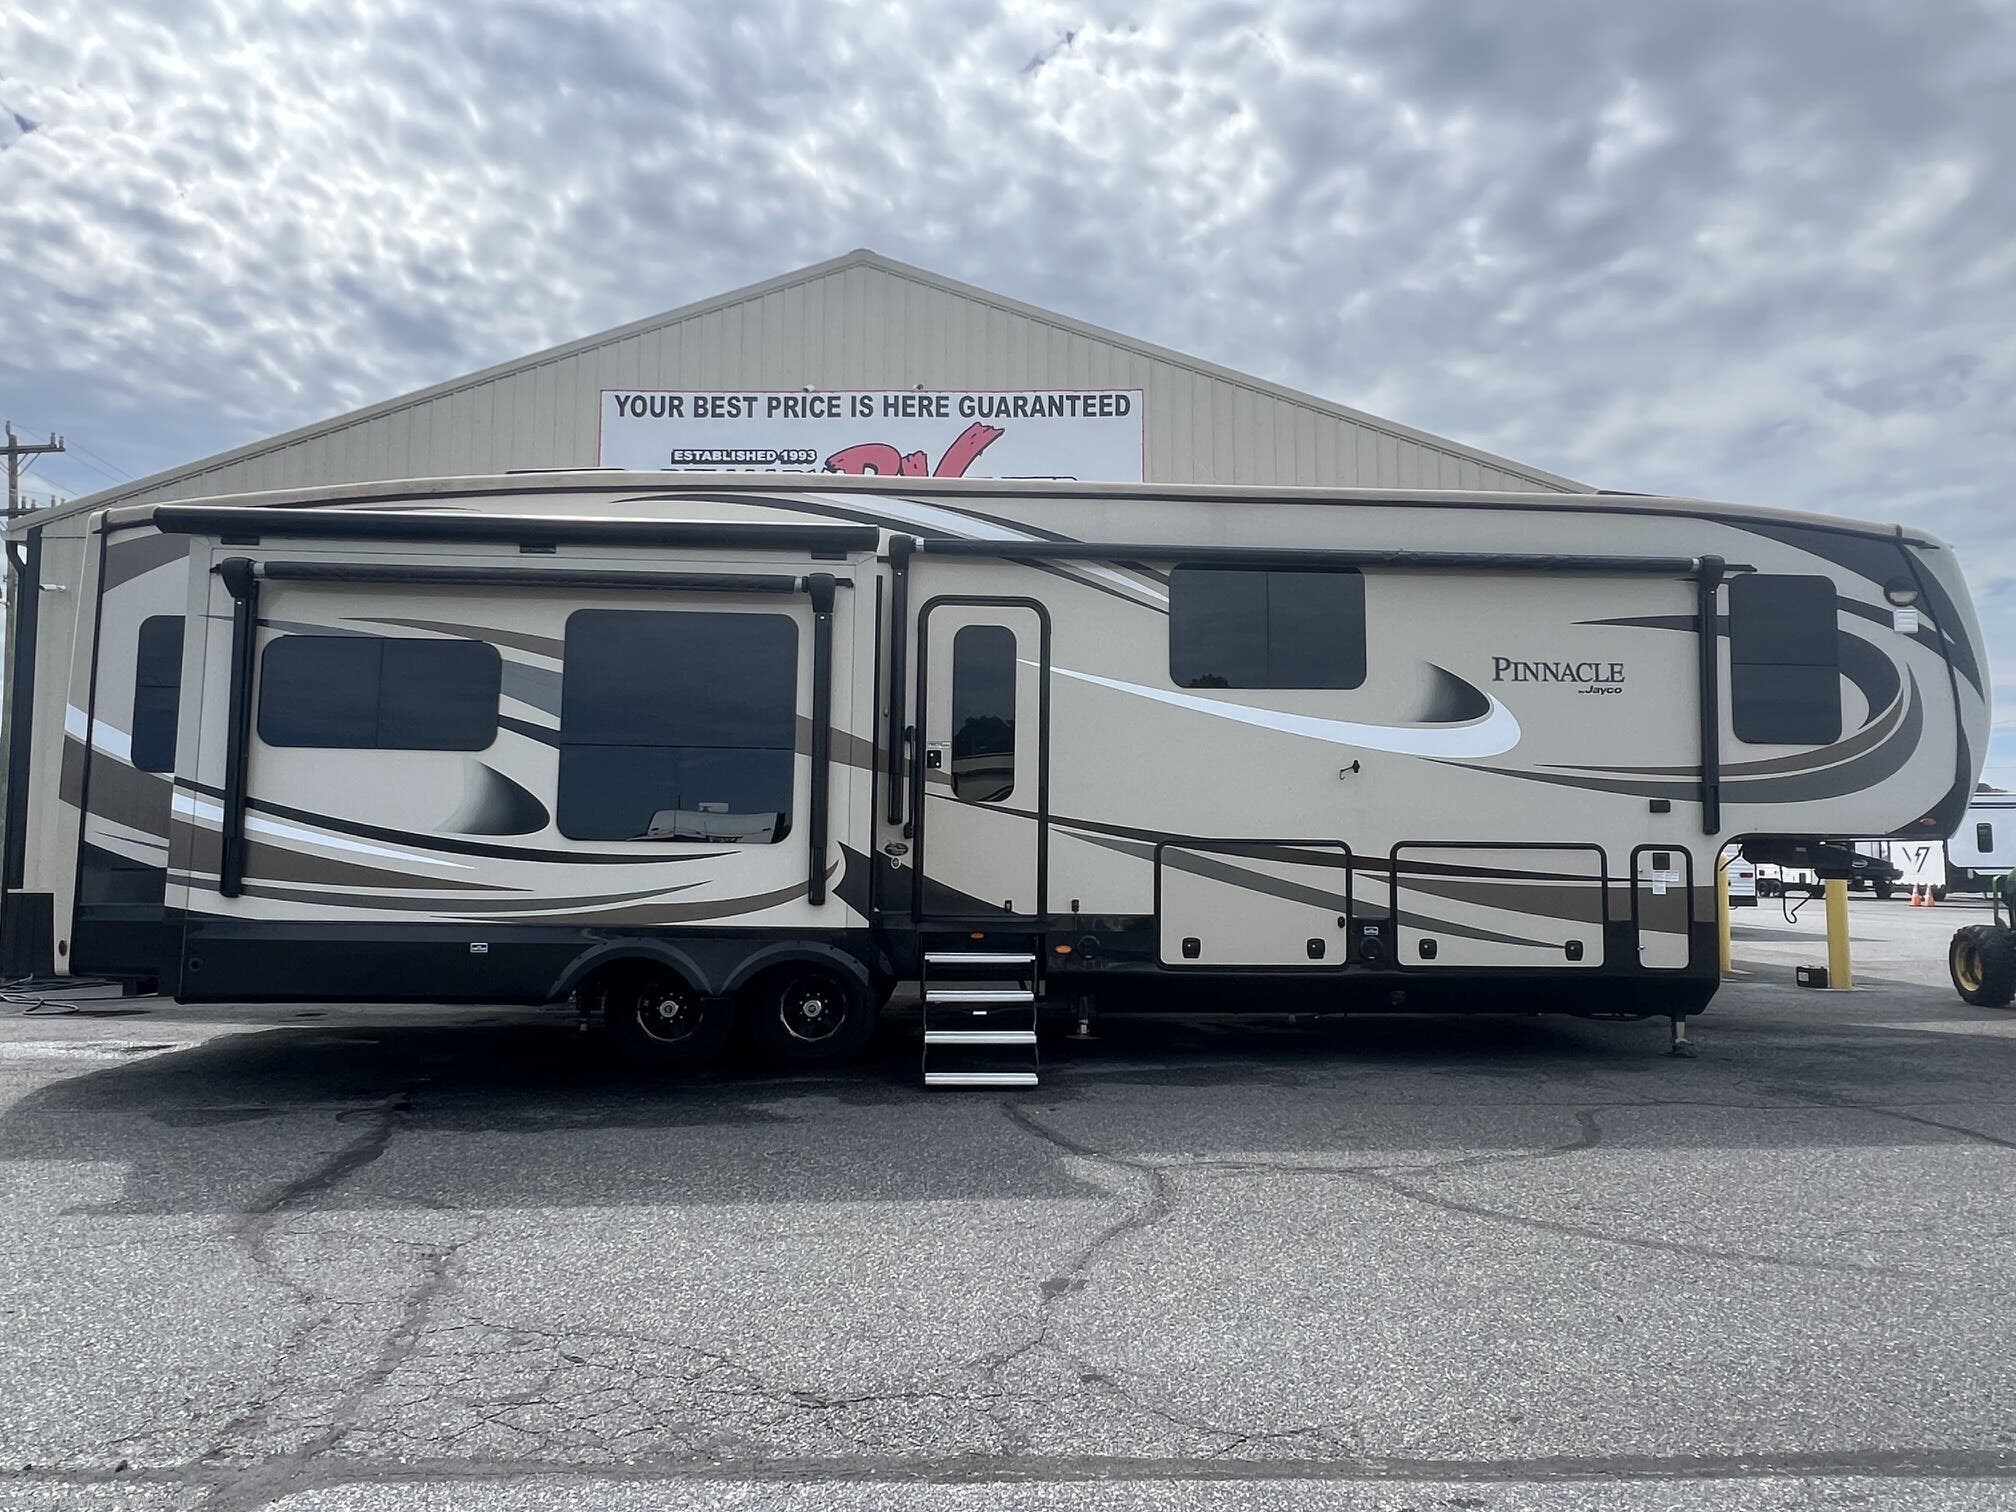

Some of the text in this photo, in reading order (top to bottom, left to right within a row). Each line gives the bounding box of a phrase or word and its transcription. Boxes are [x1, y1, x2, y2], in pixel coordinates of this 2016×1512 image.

[614, 394, 1131, 419] YOUR BEST PRICE IS HERE GUARANTEED
[672, 449, 817, 464] ESTABLISHED 1993
[1491, 656, 1626, 684] PINNACLE
[1585, 685, 1623, 696] Jayco
